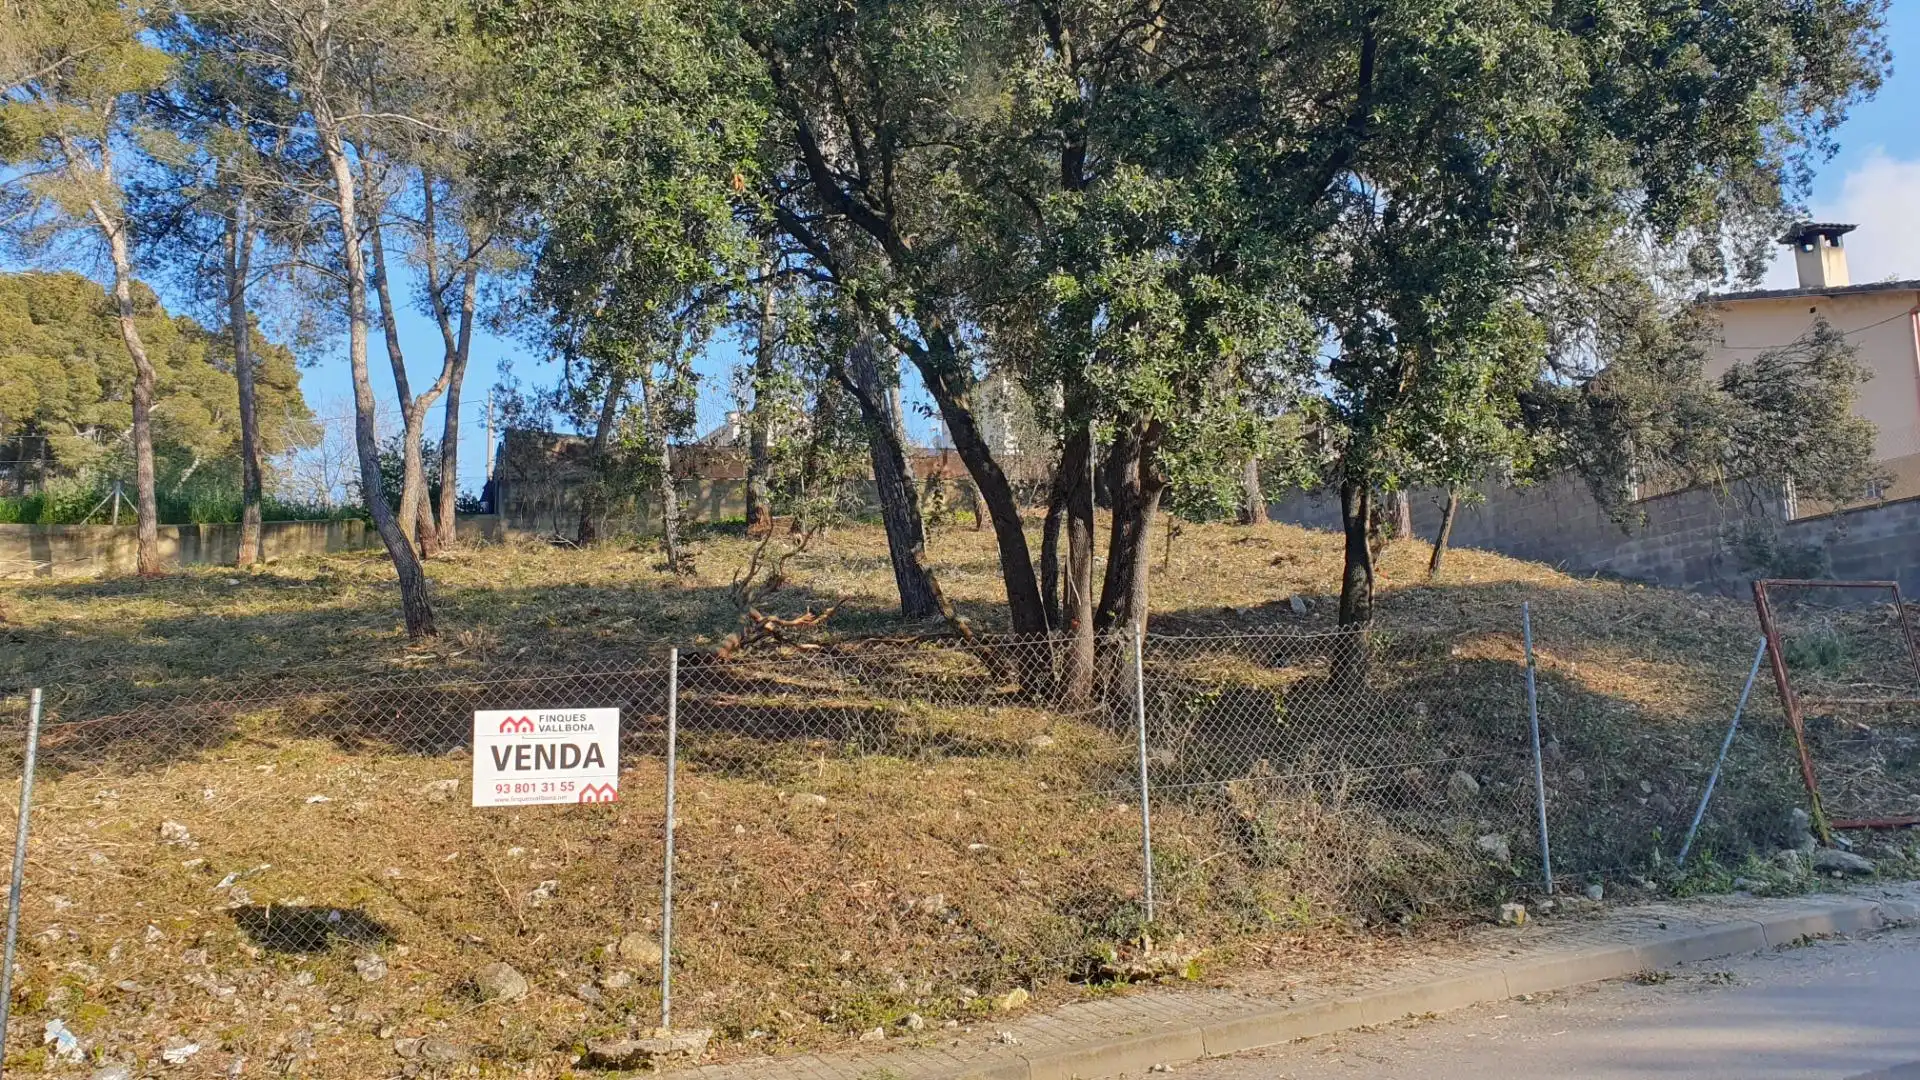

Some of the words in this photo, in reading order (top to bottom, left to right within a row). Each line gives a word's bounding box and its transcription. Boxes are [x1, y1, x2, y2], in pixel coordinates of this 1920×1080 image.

[539, 713, 586, 722] FINQUES
[538, 724, 595, 732] VALLBONA
[490, 742, 605, 772] VENDA
[495, 783, 511, 794] 93
[514, 783, 536, 793] 801
[541, 782, 555, 792] 31
[560, 781, 575, 792] 55
